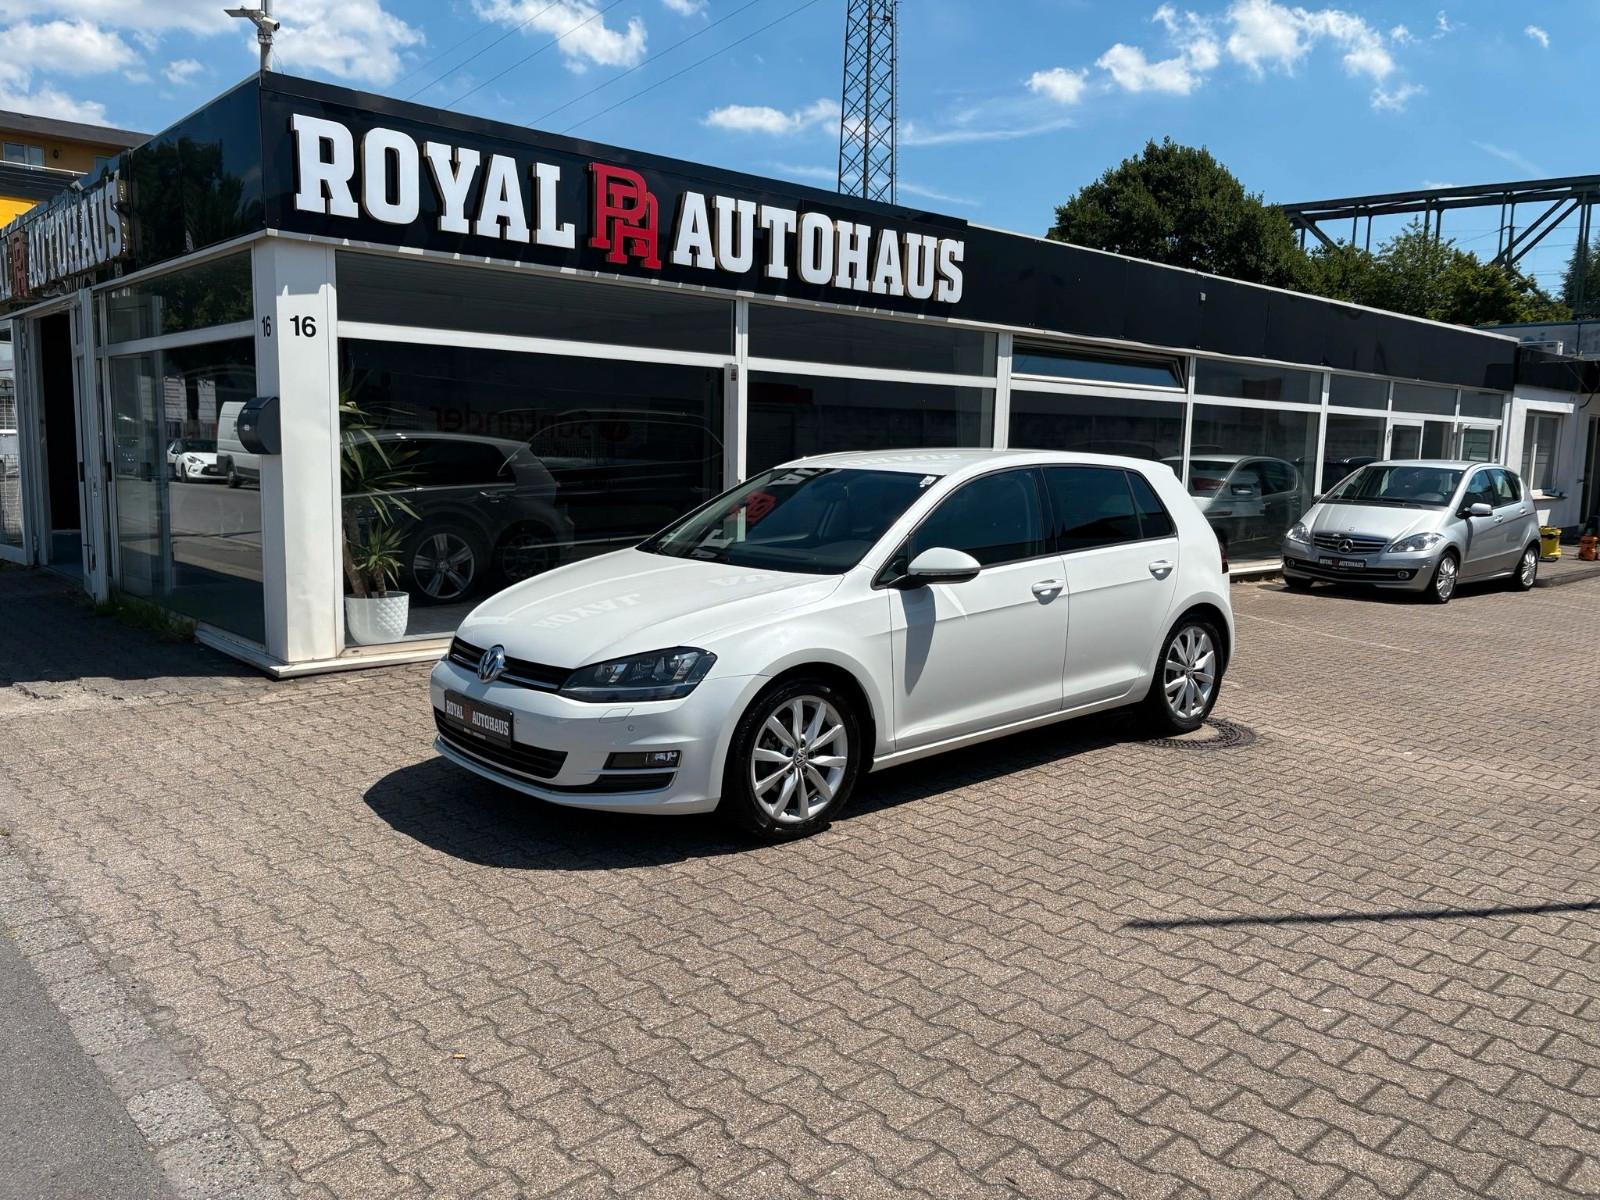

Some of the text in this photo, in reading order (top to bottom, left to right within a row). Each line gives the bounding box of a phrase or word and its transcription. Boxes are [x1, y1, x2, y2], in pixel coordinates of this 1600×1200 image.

[291, 114, 575, 249] ROYAL
[672, 191, 965, 304] AUTOHAUS
[262, 315, 271, 337] 16
[289, 315, 317, 338] 16
[446, 699, 464, 720] ROYAL
[472, 711, 509, 736] AUTOHAUS
